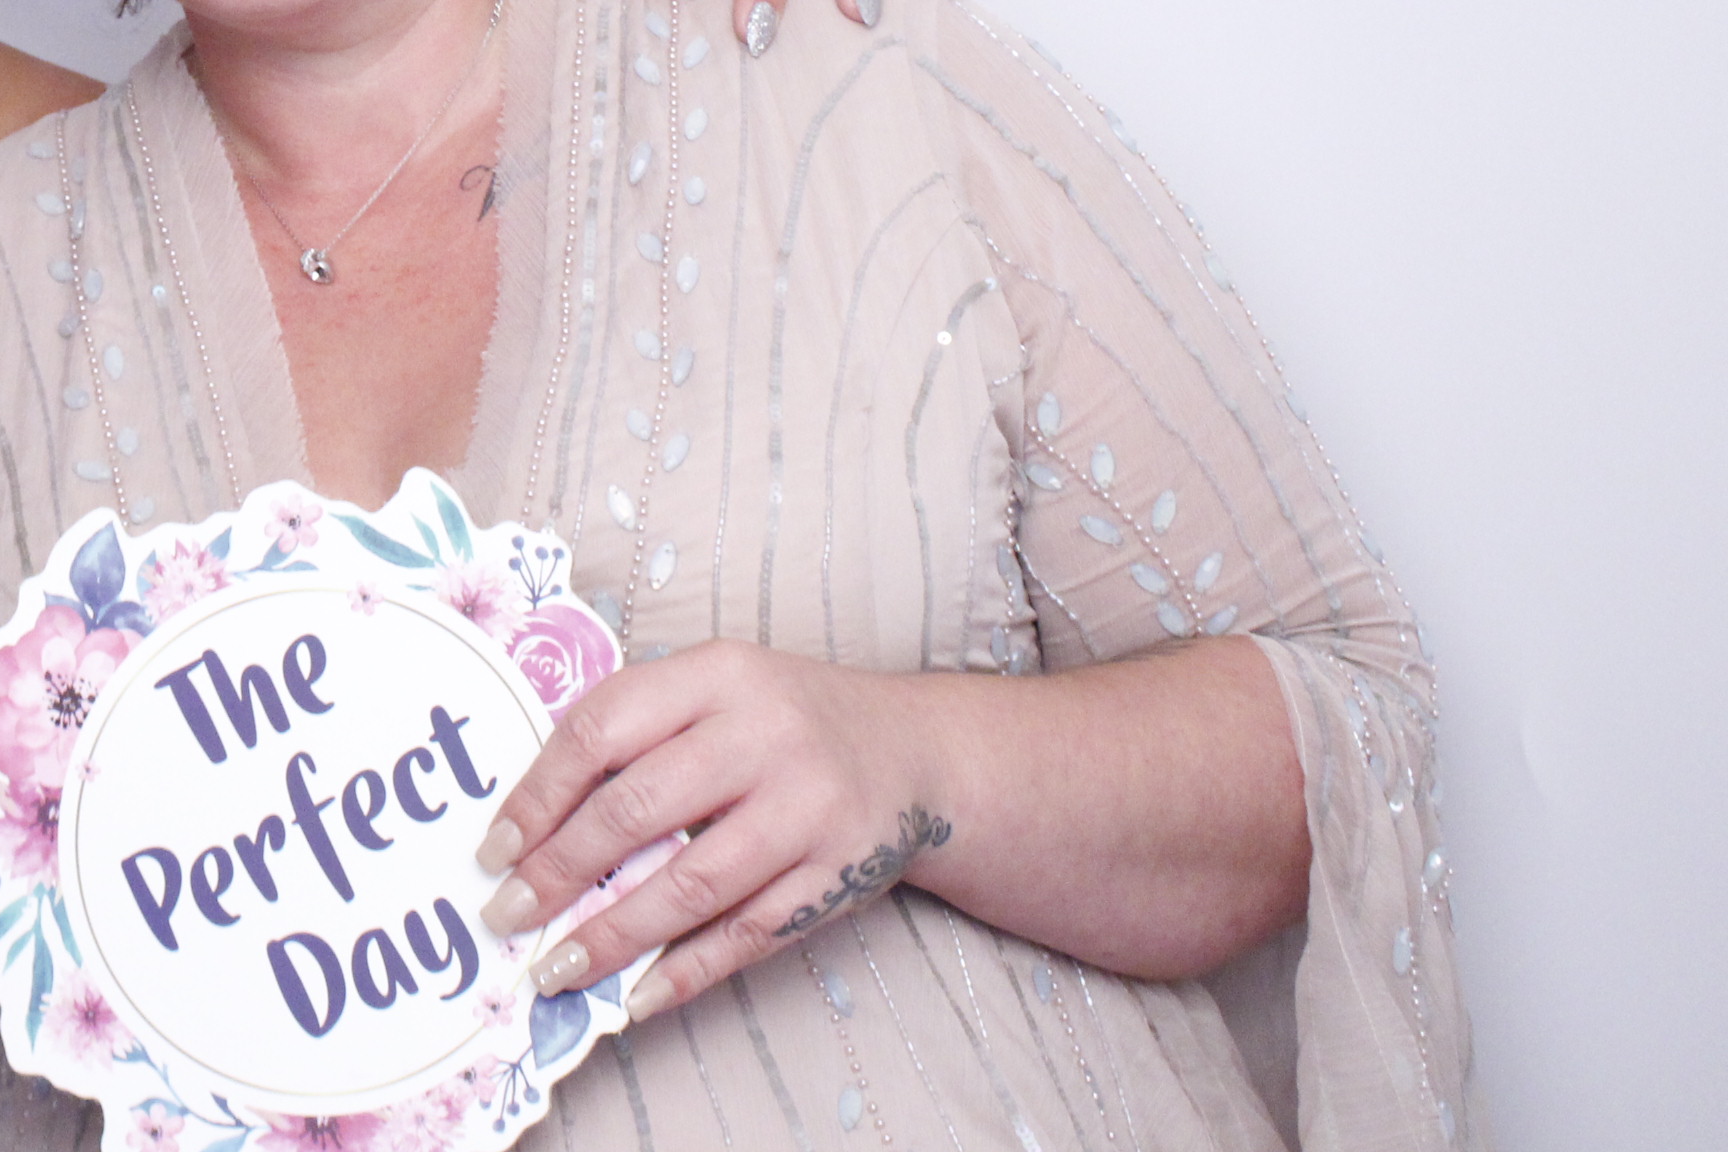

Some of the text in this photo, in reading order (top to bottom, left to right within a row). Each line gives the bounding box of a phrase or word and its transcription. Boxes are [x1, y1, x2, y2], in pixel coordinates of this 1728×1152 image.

[154, 633, 335, 764] The
[120, 705, 498, 952] Perfect
[266, 896, 481, 1039] Day
